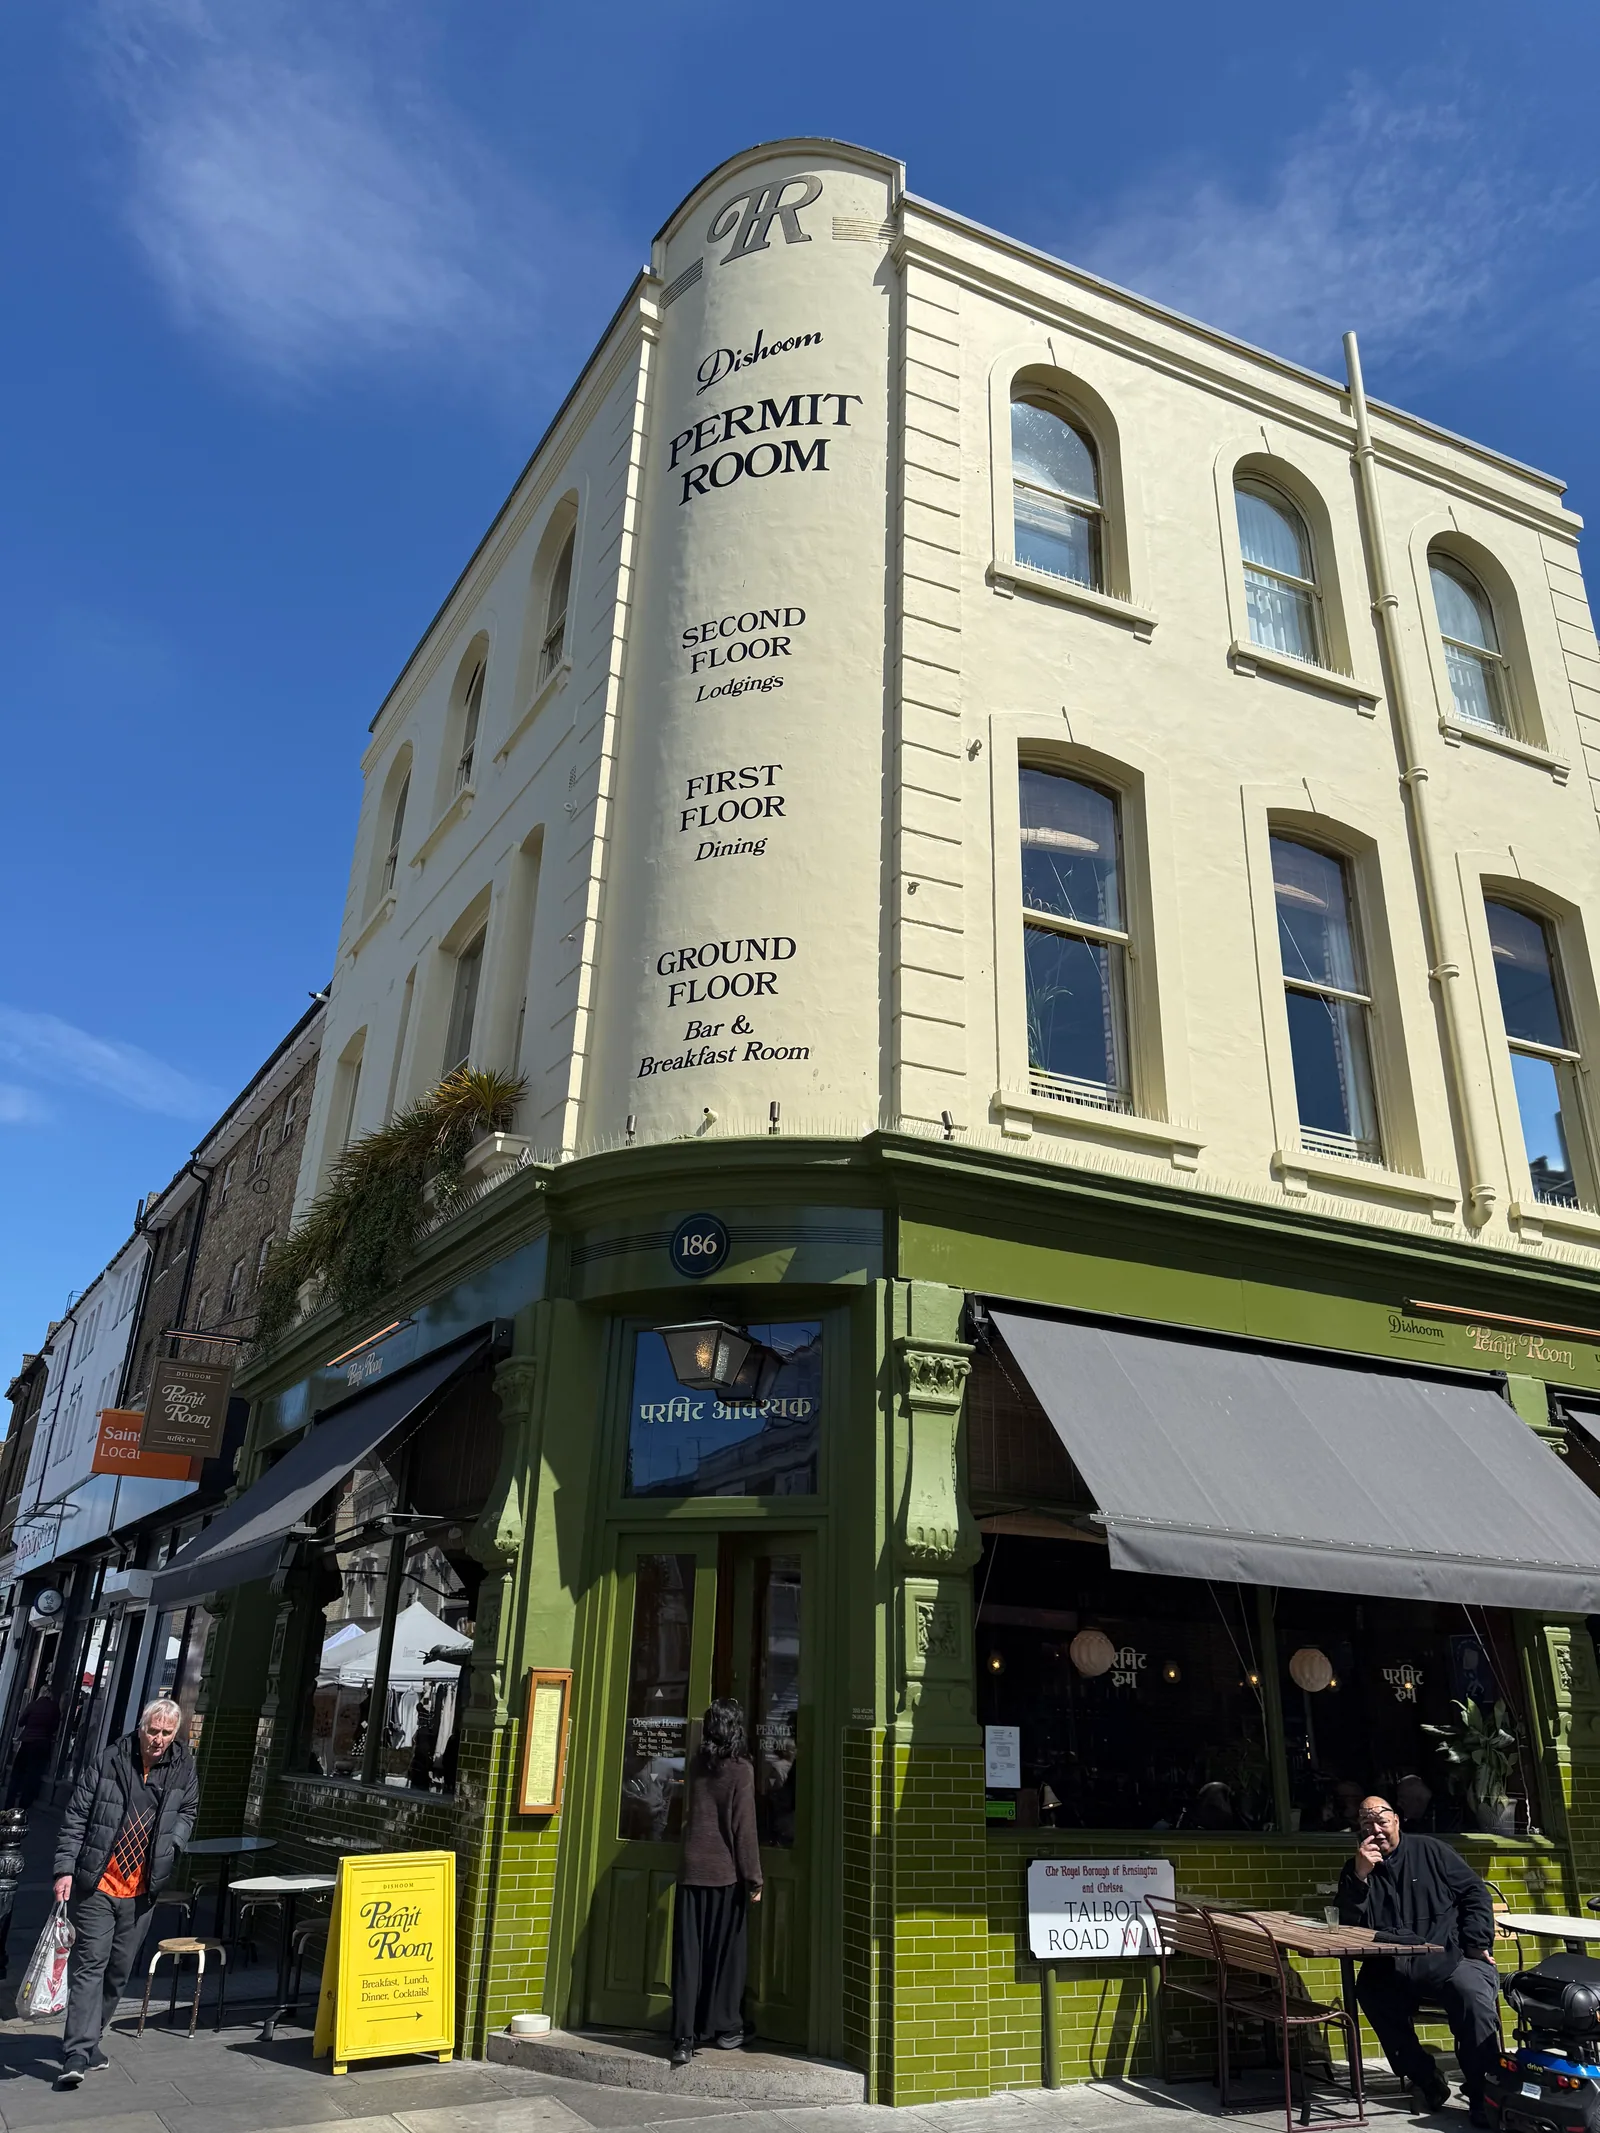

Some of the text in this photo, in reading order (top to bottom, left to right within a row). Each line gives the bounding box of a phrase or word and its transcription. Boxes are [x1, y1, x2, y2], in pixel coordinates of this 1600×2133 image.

[696, 329, 824, 396] Dishoom
[667, 393, 864, 472] PERMIT
[678, 438, 832, 507] ROOM
[682, 607, 806, 649] SECOND
[690, 636, 792, 675] FLOOR
[695, 675, 784, 703] Lodgings
[685, 764, 783, 801] FIRST
[679, 795, 786, 833] FLOOR
[694, 837, 768, 861] Dining
[656, 936, 797, 976] GROUND
[667, 971, 778, 1008] FLOOR
[683, 1014, 754, 1042] Bar &
[637, 1041, 810, 1079] Breakfast Room
[681, 1233, 718, 1256] 186
[1388, 1315, 1445, 1338] Dishoom
[1465, 1323, 1576, 1371] Permit Room
[176, 1371, 211, 1380] DISHOOM
[161, 1384, 207, 1409] Permit
[164, 1403, 211, 1429] Room
[640, 1396, 706, 1424] परमिट
[1110, 1646, 1148, 1670] रमिट
[632, 1718, 683, 1729] Opening Hours
[756, 1724, 793, 1736] PERMIT
[1045, 1864, 1158, 1880] The Royal Borough of Kensington
[383, 1882, 414, 1890] DISHOOM
[1082, 1882, 1124, 1894] and Chelsea
[360, 1901, 422, 1933] Permit
[1064, 1900, 1142, 1923] TALBOT
[368, 1931, 434, 1962] Room
[1048, 1928, 1109, 1951] ROAD
[361, 1987, 430, 2002] Dinner, Cocktails!
[362, 1974, 429, 1989] Breakfast, Lunch,
[1527, 2062, 1543, 2072] drive
